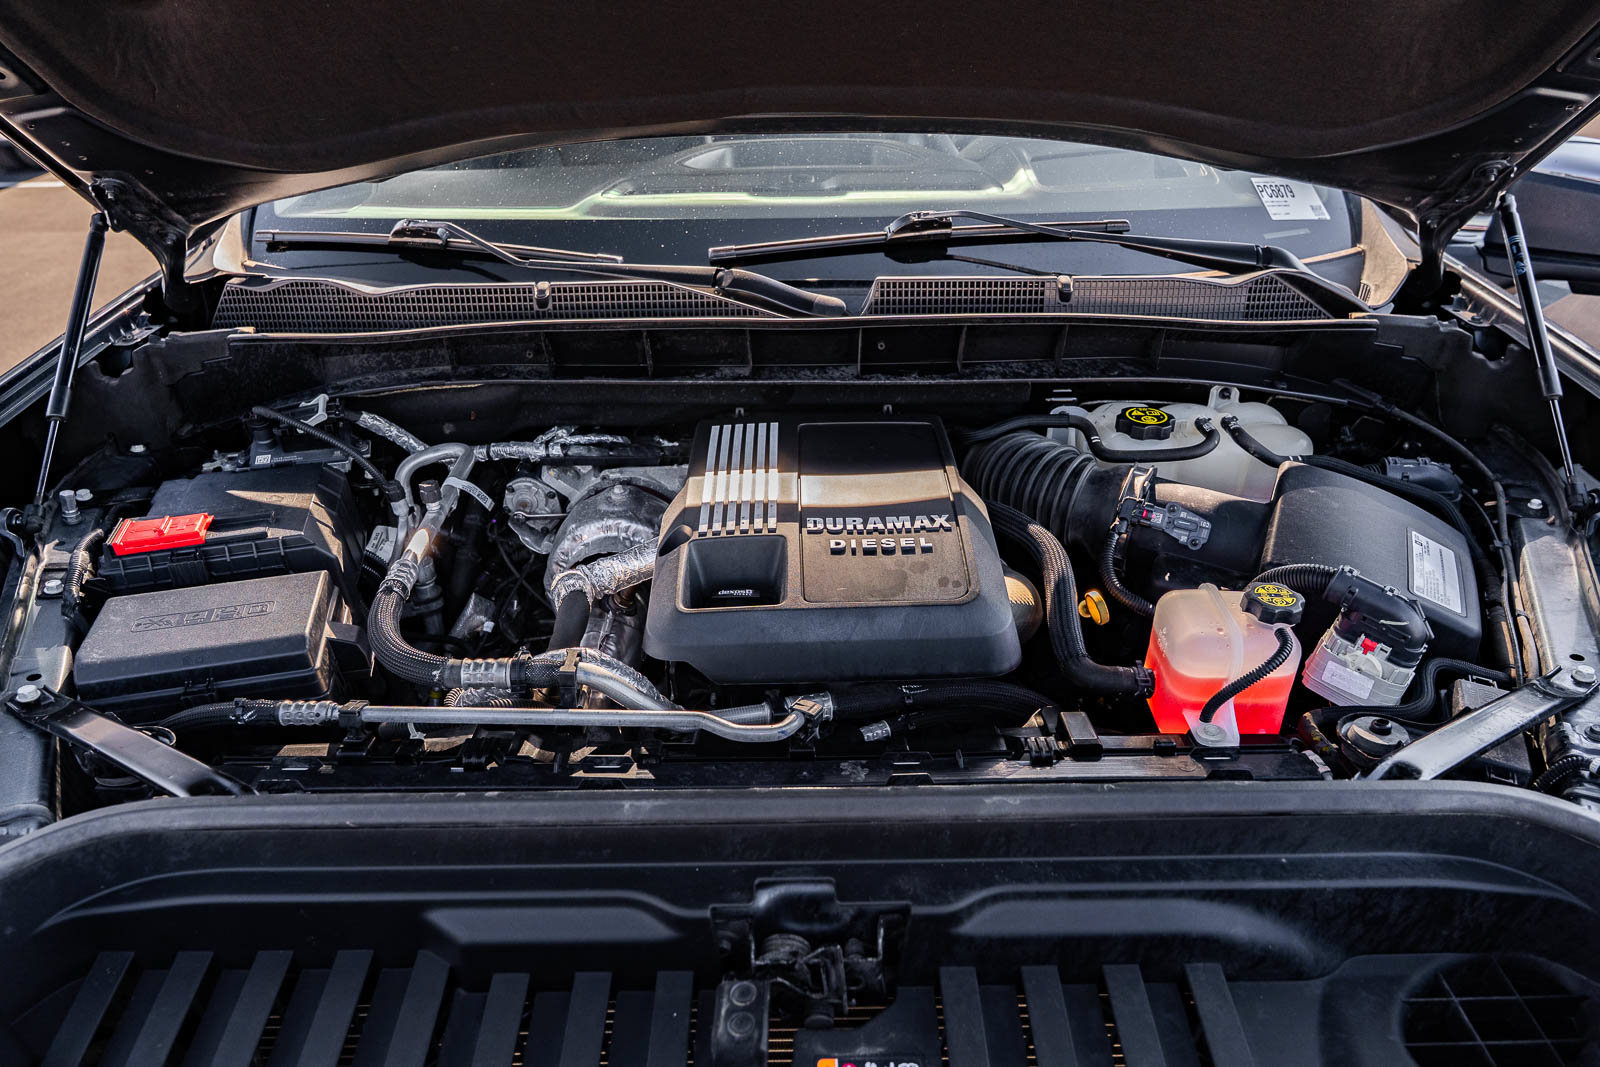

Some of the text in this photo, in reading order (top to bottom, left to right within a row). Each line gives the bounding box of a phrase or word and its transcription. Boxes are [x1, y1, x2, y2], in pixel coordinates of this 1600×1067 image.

[1256, 184, 1296, 199] PC6879
[806, 513, 953, 534] DURAMAX
[829, 537, 934, 555] DIESEL
